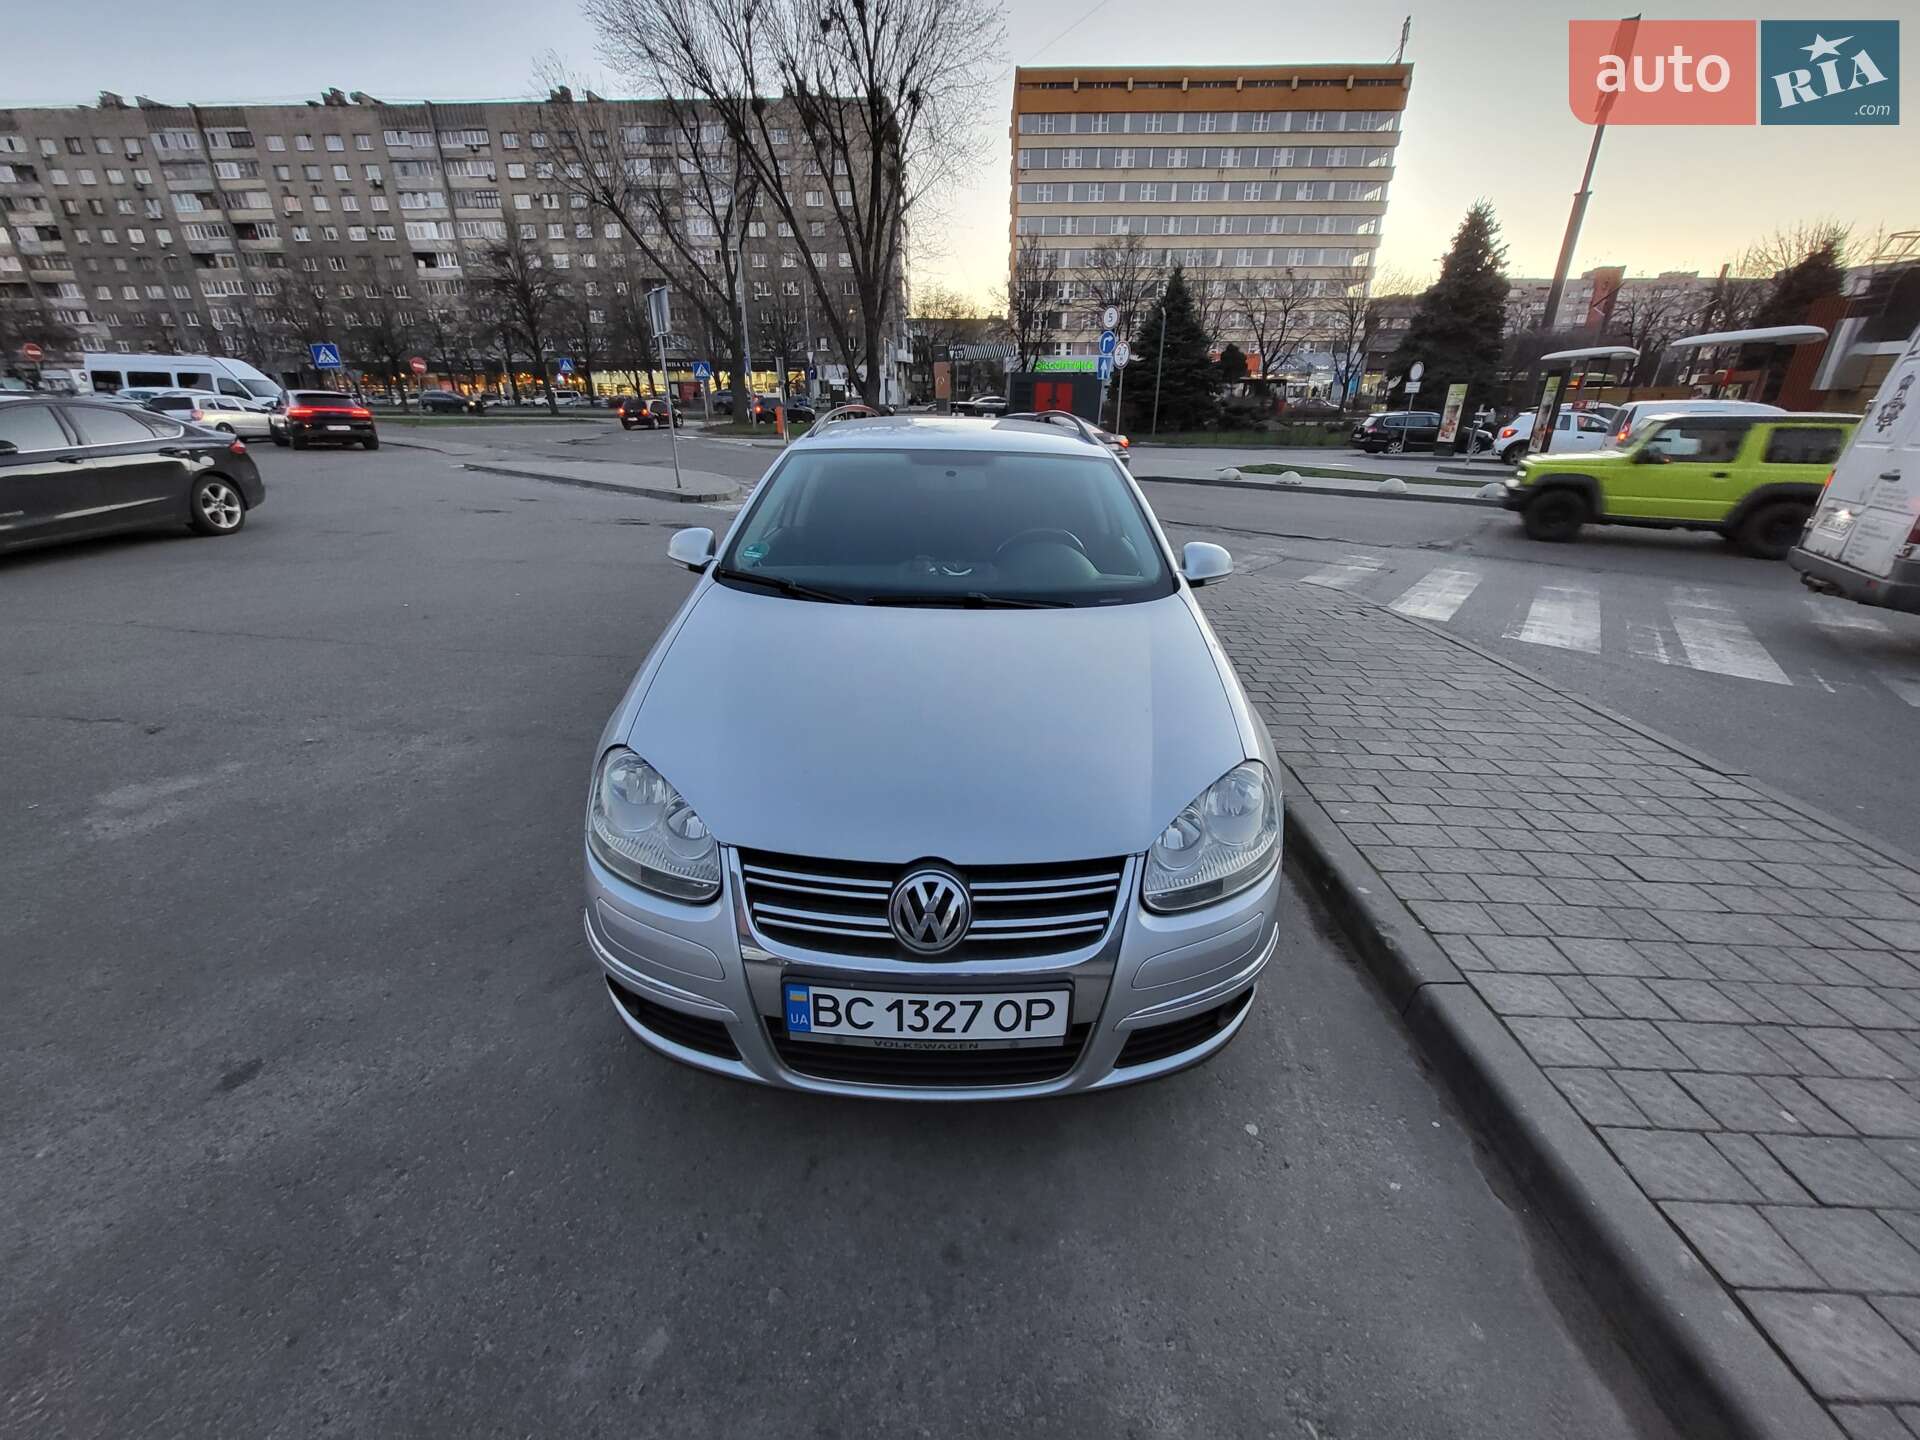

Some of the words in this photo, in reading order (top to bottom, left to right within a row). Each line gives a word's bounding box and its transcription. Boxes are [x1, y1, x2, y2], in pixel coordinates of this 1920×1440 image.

[790, 1013, 809, 1026] UA
[812, 993, 874, 1030] BC
[885, 999, 984, 1034] 1327
[993, 998, 1056, 1032] OP
[873, 1038, 979, 1050] VOLKSWAGEN
